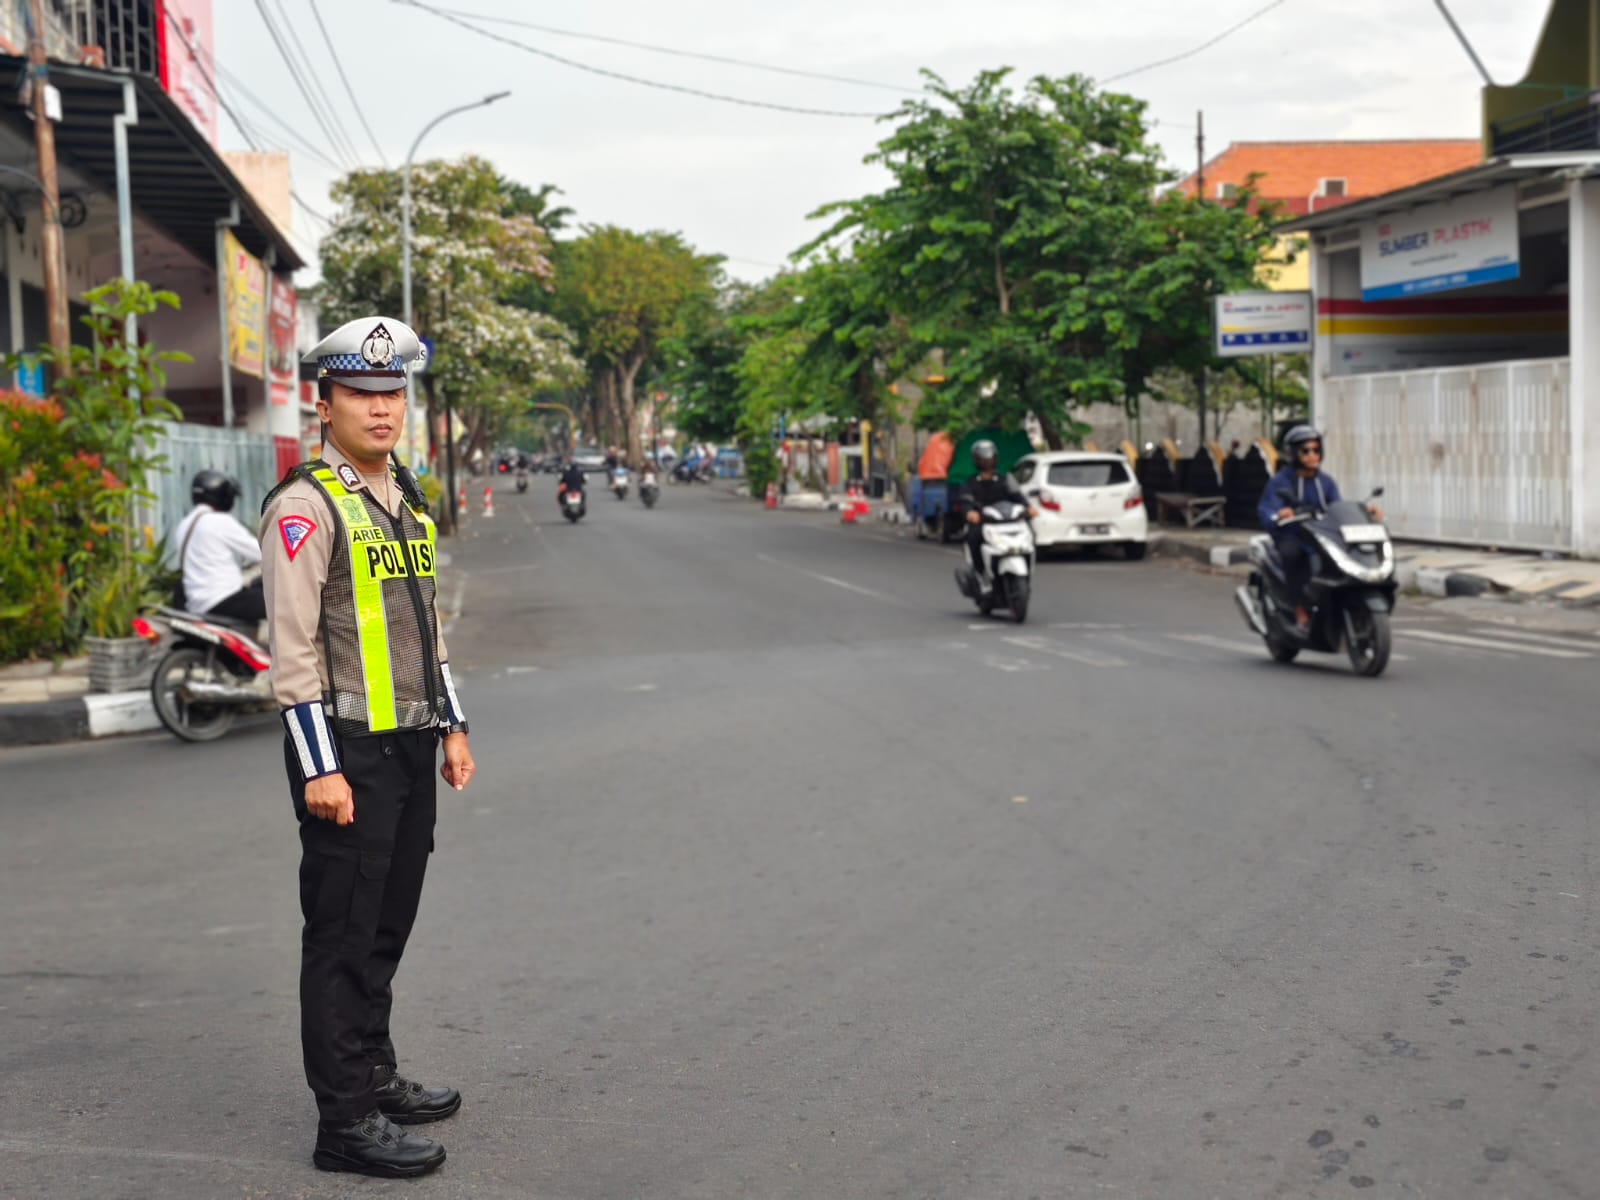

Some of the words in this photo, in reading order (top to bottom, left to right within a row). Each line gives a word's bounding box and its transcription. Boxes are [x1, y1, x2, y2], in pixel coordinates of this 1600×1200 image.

[1379, 232, 1428, 257] SUMBER
[1434, 218, 1492, 244] PLASTIK
[352, 528, 383, 543] ARIE
